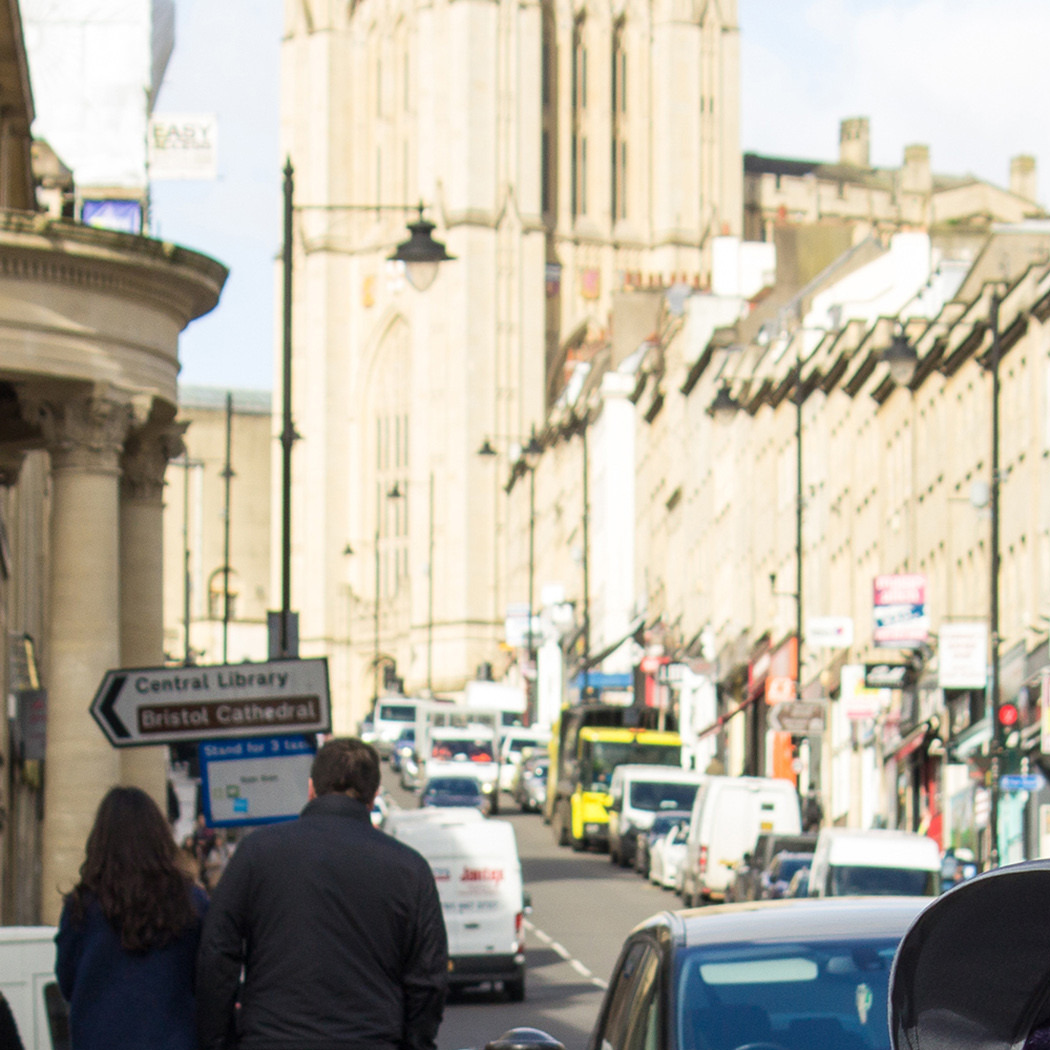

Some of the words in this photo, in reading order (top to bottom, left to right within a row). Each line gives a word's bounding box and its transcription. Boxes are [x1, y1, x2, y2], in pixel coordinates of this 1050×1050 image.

[153, 123, 211, 139] EASY
[135, 675, 209, 694] Central
[218, 671, 288, 689] Library
[140, 708, 209, 728] Bristol
[216, 700, 316, 722] Cathedral
[204, 743, 242, 756] Stand
[247, 741, 264, 753] for
[271, 739, 280, 752] 3
